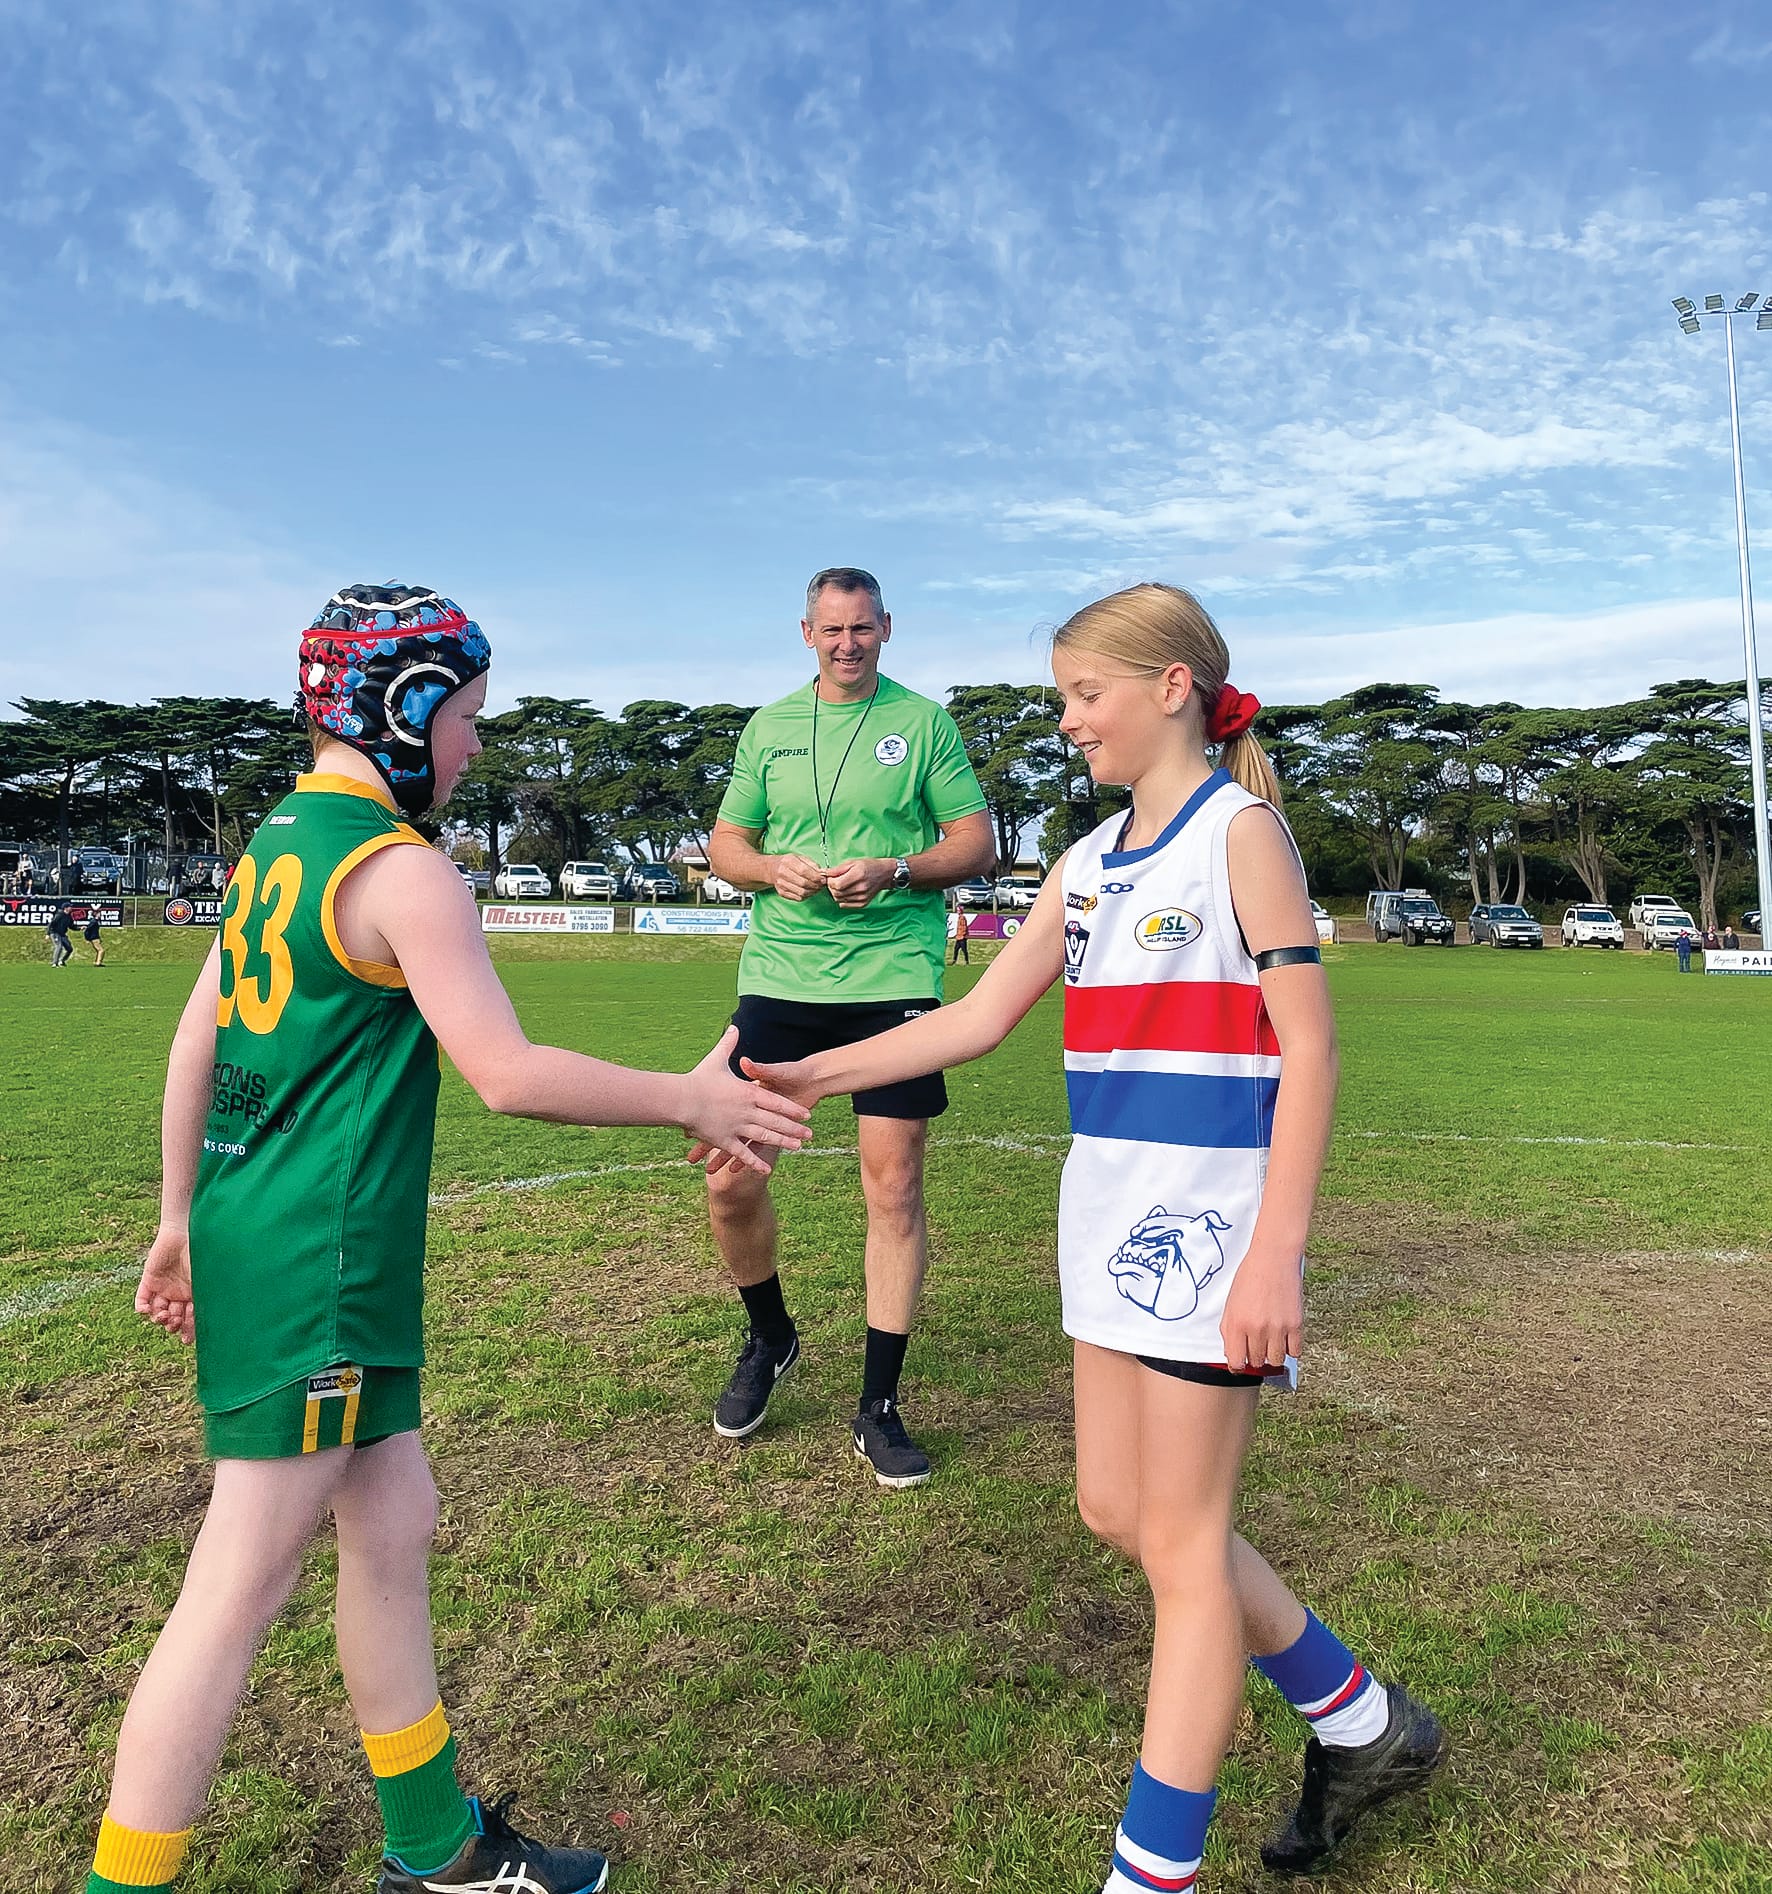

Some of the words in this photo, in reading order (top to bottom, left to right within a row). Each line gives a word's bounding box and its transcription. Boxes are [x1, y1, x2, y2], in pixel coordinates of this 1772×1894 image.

[772, 748, 808, 758] UMPIRE
[485, 908, 567, 924] MELSTEEL
[1158, 916, 1187, 932] RSL
[217, 854, 303, 1034] 33
